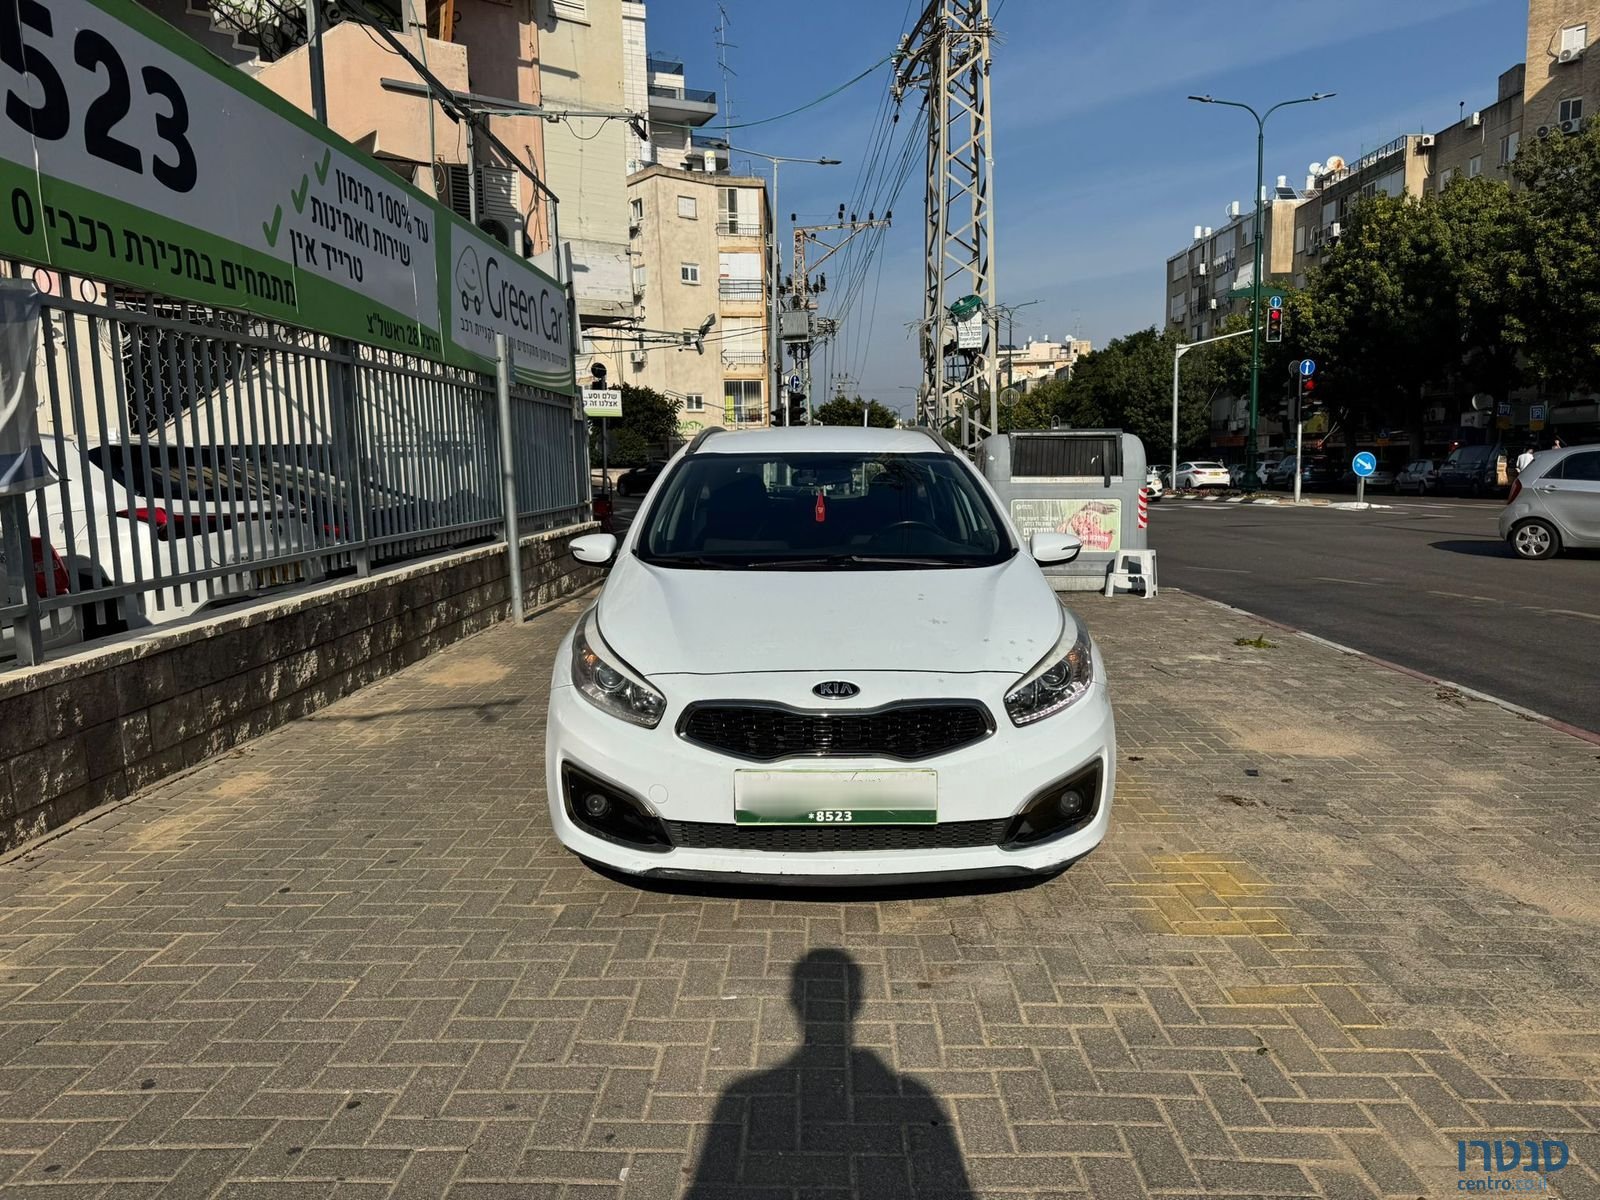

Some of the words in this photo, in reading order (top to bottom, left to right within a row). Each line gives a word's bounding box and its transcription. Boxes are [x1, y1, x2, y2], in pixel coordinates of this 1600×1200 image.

[335, 168, 375, 214] מימון
[43, 204, 116, 259] רכבי
[310, 195, 370, 247] ואמינות
[413, 216, 430, 243] עד
[123, 228, 217, 285] במכירת
[289, 229, 317, 268] אין
[321, 242, 364, 283] טרייד
[372, 228, 411, 267] שירות
[220, 257, 298, 307] מתמחים
[486, 256, 539, 336] Green
[540, 289, 563, 345] Car
[406, 324, 419, 347] 28
[420, 328, 441, 353] הרצל
[460, 317, 474, 334] רכב
[602, 391, 618, 400] שלם
[820, 683, 853, 694] KIA
